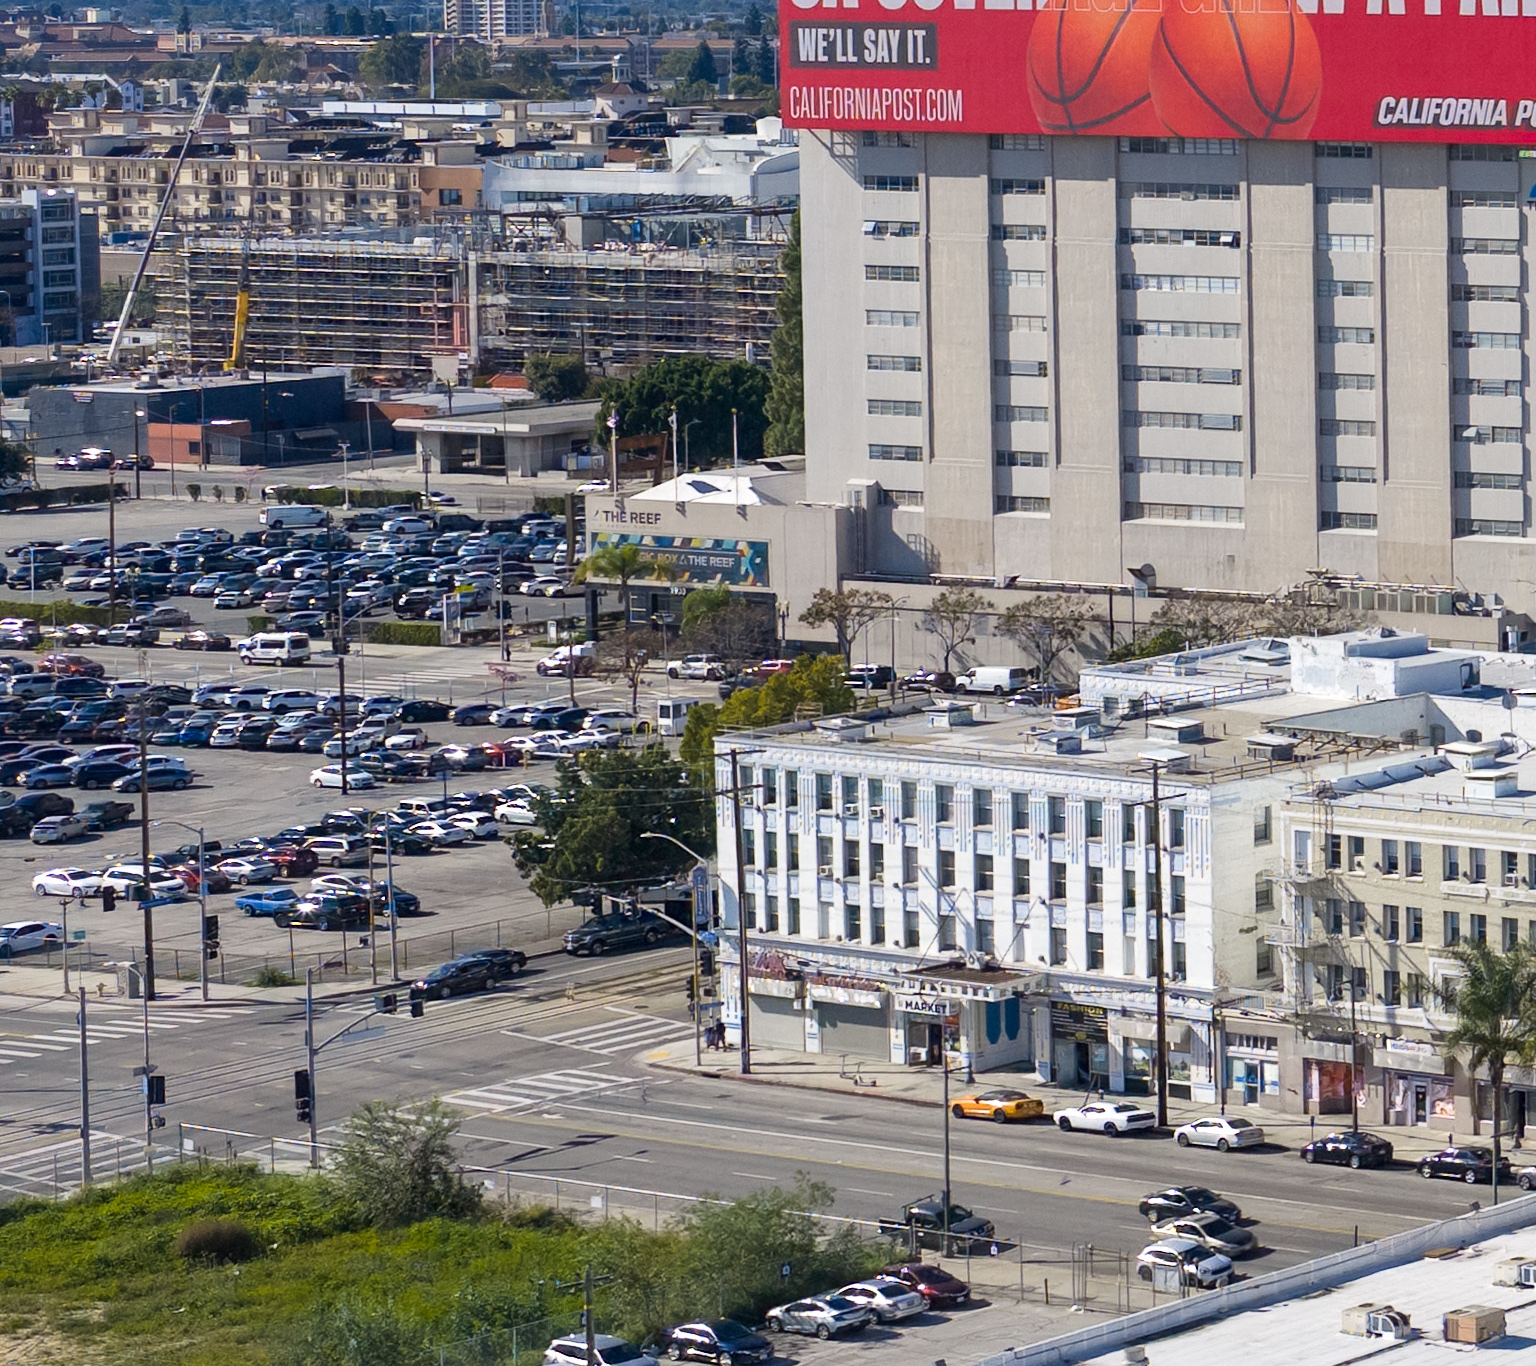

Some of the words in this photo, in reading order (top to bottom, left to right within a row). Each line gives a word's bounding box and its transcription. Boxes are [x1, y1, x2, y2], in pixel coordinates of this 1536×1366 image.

[797, 26, 858, 63] WE'LL
[863, 29, 901, 64] SAY
[906, 29, 931, 65] IT.
[790, 85, 963, 122] CALIFORNIAPOST.COM
[1378, 96, 1509, 127] CALIFORNIA
[602, 510, 627, 523] THE
[630, 512, 662, 525] REEF
[688, 555, 707, 566] THE
[710, 556, 735, 568] REEF
[904, 999, 948, 1014] MARKET
